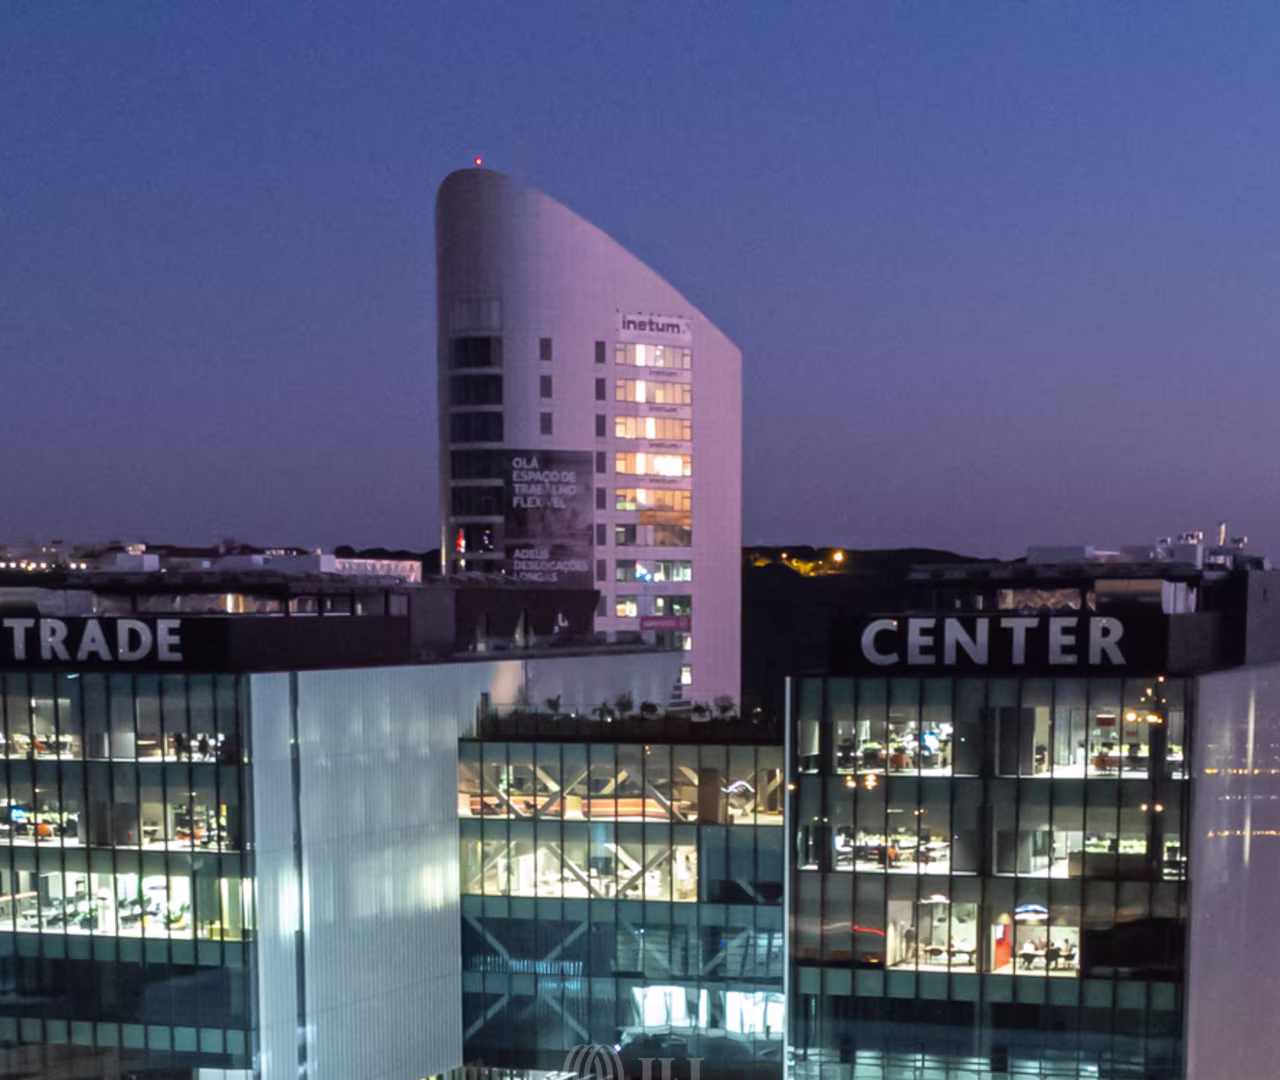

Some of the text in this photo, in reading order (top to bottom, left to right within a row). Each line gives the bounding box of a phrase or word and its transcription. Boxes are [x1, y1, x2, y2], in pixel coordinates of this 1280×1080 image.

[561, 471, 576, 483] DE
[2, 617, 184, 662] TRADE
[860, 616, 1127, 667] CENTER
